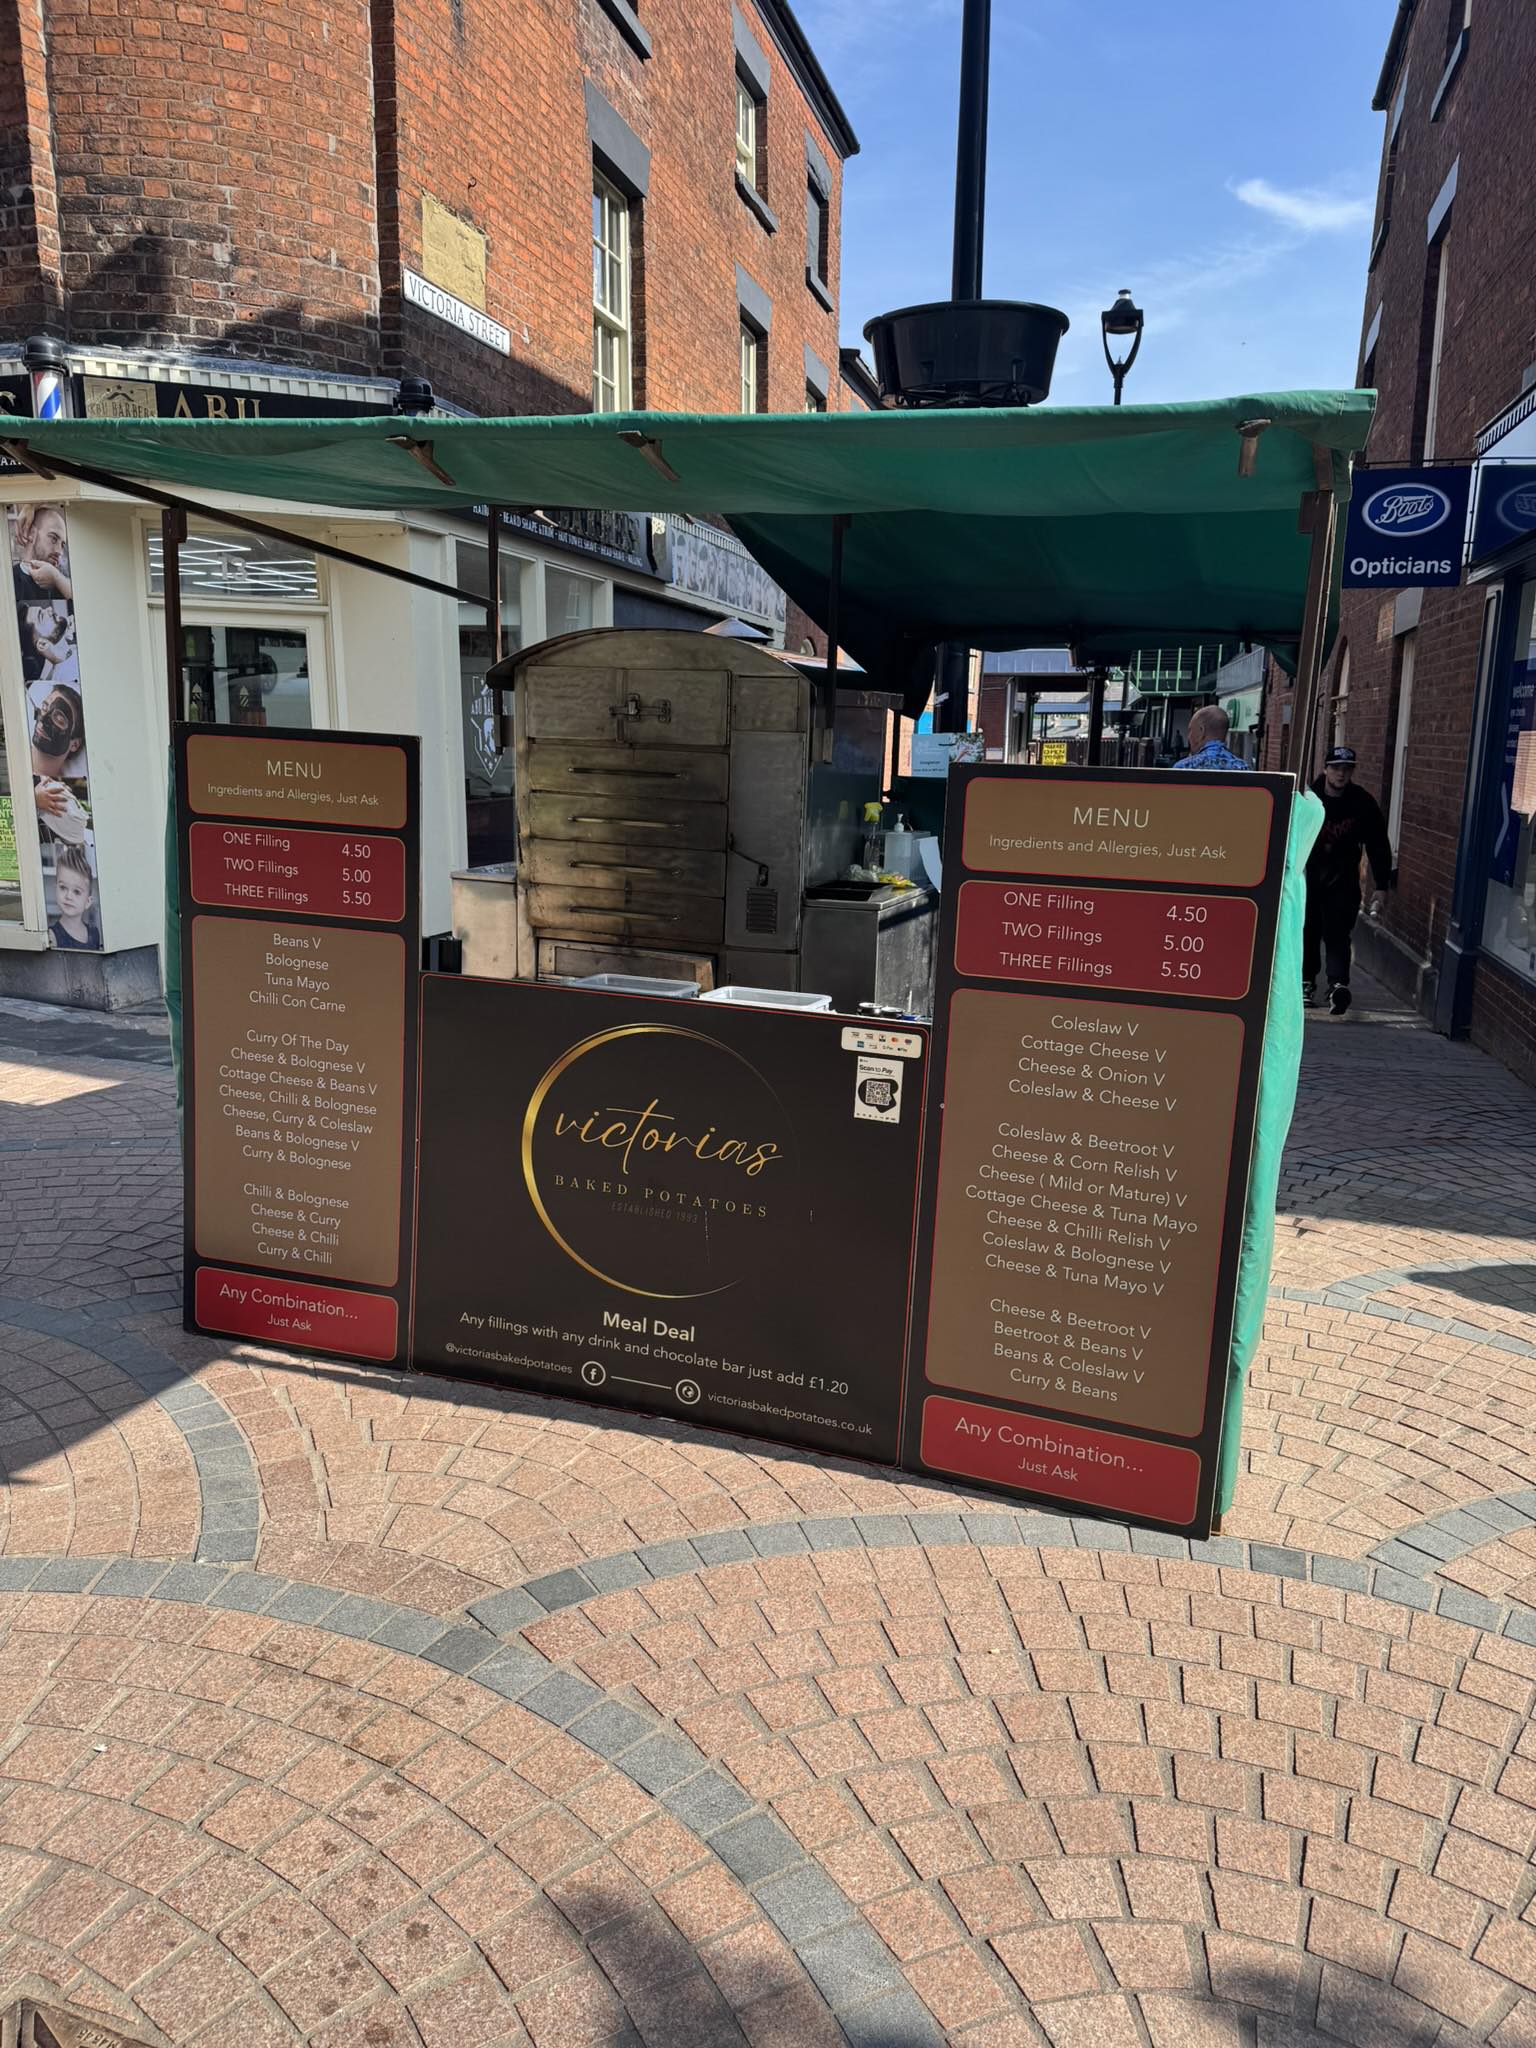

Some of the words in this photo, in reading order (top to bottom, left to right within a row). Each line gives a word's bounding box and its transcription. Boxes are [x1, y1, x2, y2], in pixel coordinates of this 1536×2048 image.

[409, 275, 465, 327] VICTORIA
[468, 312, 506, 350] STREET
[1375, 494, 1434, 524] Boots
[218, 554, 248, 581] 13
[1350, 557, 1451, 578] Opticians
[267, 759, 321, 779] MENU
[207, 783, 263, 797] Ingredients
[265, 787, 284, 798] and
[286, 788, 334, 804] Allergies,
[336, 792, 357, 804] Just
[360, 794, 379, 805] Ask
[1073, 806, 1149, 828] MENU
[223, 831, 251, 845] ONE
[255, 833, 290, 851] Filling
[341, 843, 370, 858] 4.50
[989, 834, 1064, 851] Ingredients
[1067, 839, 1093, 852] and
[1097, 839, 1161, 858] Allergies,
[1166, 843, 1196, 857] Just
[1199, 845, 1226, 859] Ask
[223, 856, 254, 871] TWO
[258, 860, 298, 878] Fillings
[342, 867, 371, 883] 5.00
[224, 882, 264, 898] THREE
[267, 886, 308, 904] Fillings
[342, 890, 371, 905] 5.50
[1003, 891, 1042, 907] ONE
[1047, 894, 1094, 915] Filling
[1166, 905, 1207, 922] 4.50
[273, 932, 309, 948] Beans
[312, 936, 321, 949] V
[1001, 921, 1042, 938] TWO
[1047, 925, 1102, 946] Fillings
[1163, 934, 1204, 952] 5.00
[265, 952, 328, 971] Bolognese
[999, 951, 1052, 969] THREE
[1057, 956, 1112, 977] Fillings
[1160, 961, 1200, 979] 5.50
[264, 972, 293, 986] Tuna
[296, 975, 330, 992] Mayo
[249, 990, 278, 1004] Chilli
[281, 993, 306, 1008] Con
[310, 996, 346, 1012] Carne
[1051, 1014, 1122, 1034] Coleslaw
[1127, 1022, 1139, 1036] V
[246, 1029, 278, 1047] Curry
[281, 1033, 297, 1046] Of
[299, 1035, 322, 1049] The
[325, 1038, 349, 1055] Day
[1021, 1034, 1084, 1056] Cottage
[1089, 1041, 1149, 1061] Cheese
[1154, 1048, 1166, 1063] V
[1018, 1057, 1076, 1076] Cheese
[1080, 1064, 1093, 1078] &
[1098, 1066, 1147, 1084] Onion
[1153, 1072, 1165, 1086] V
[219, 1083, 265, 1102] Cheese,
[268, 1090, 297, 1104] Chilli
[301, 1094, 310, 1106] &
[314, 1095, 376, 1115] Bolognese
[222, 1103, 269, 1122] Cheese,
[272, 1110, 304, 1128] Curry
[306, 1114, 316, 1127] &
[320, 1116, 373, 1134] Coleslaw
[235, 1124, 270, 1140] Beans
[273, 1129, 282, 1142] &
[286, 1130, 348, 1150] Bolognese
[350, 1139, 360, 1151] V
[555, 1098, 783, 1176] victorias
[998, 1122, 1066, 1143] Coleslaw
[1070, 1131, 1082, 1146] &
[1088, 1134, 1158, 1156] Beetroot
[1162, 1143, 1174, 1158] V
[991, 1144, 1048, 1164] Cheese
[1053, 1152, 1064, 1166] &
[1070, 1154, 1107, 1172] Corn
[1113, 1160, 1159, 1180] Relish
[1165, 1167, 1177, 1181] V
[555, 1175, 627, 1194] BAKED
[644, 1187, 766, 1217] POTATOES
[979, 1164, 1035, 1184] Cheese
[1049, 1174, 1083, 1191] Mild
[1087, 1183, 1104, 1194] or
[1109, 1183, 1170, 1207] Mature)
[1175, 1192, 1187, 1207] V
[611, 1201, 672, 1219] ESTABLISHED
[965, 1184, 1025, 1207] Cottage
[1030, 1194, 1087, 1215] Cheese
[1092, 1203, 1104, 1218] &
[1110, 1205, 1146, 1224] Tuna
[1153, 1212, 1197, 1234] Mayo
[986, 1209, 1042, 1230] Cheese
[1047, 1219, 1058, 1233] &
[1064, 1222, 1102, 1240] Chilli
[1107, 1228, 1152, 1248] Relish
[1159, 1237, 1170, 1250] V
[219, 1283, 247, 1304] Any
[251, 1288, 358, 1319] Combination...
[267, 1314, 289, 1327] Just
[291, 1318, 312, 1331] Ask
[603, 1311, 646, 1333] Meal
[653, 1320, 694, 1342] Deal
[459, 1311, 484, 1329] Any
[488, 1315, 528, 1335] fillings
[531, 1326, 558, 1338] with
[562, 1332, 584, 1346] any
[588, 1333, 620, 1350] drink
[624, 1343, 649, 1355] and
[653, 1346, 718, 1368] chocolate
[722, 1358, 745, 1375] bar
[747, 1362, 774, 1381] just
[776, 1371, 804, 1386] add
[808, 1376, 848, 1395] £1.20
[994, 1320, 1059, 1345] Beetroot
[1063, 1334, 1075, 1348] &
[1080, 1336, 1127, 1358] Beans
[1132, 1346, 1143, 1360] V
[445, 1342, 572, 1374] @victoriasbakedpotatoes
[1010, 1367, 1050, 1390] Curry
[1054, 1376, 1066, 1391] &
[1071, 1380, 1117, 1401] Beans
[707, 1393, 872, 1434] victoriasbakedpotatoes.co.uk
[954, 1416, 992, 1442] Any
[998, 1425, 1142, 1472] Combination...
[1017, 1457, 1047, 1474] Just
[1051, 1464, 1078, 1481] Ask
